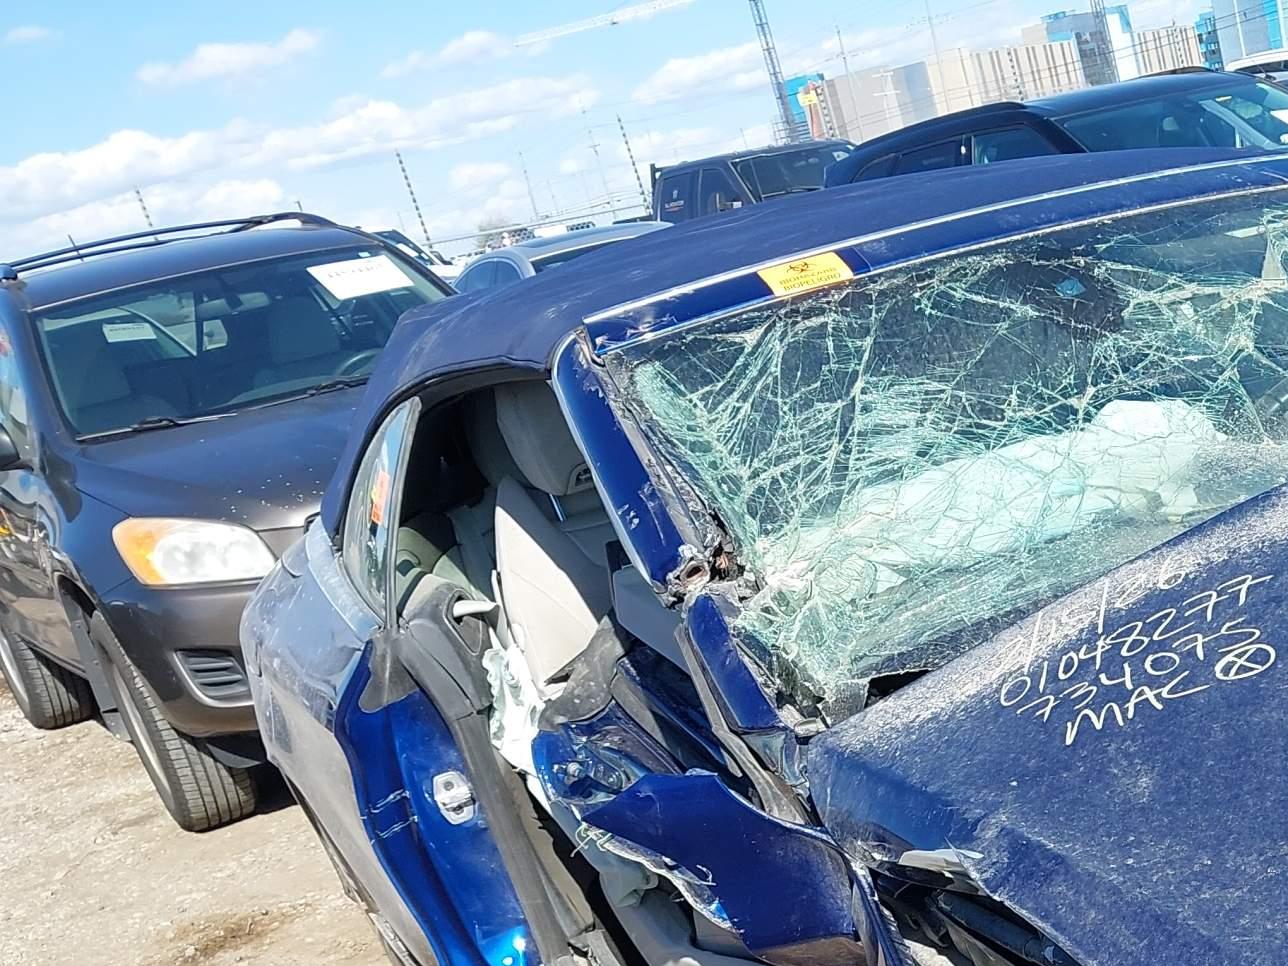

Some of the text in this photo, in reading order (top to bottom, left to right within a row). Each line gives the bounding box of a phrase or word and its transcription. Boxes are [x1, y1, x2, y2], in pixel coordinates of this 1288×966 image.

[783, 273, 842, 292] BIOPELIGRO
[1000, 574, 1273, 707] 01048277
[1016, 617, 1261, 723] 734075
[1065, 670, 1210, 746] MAC
